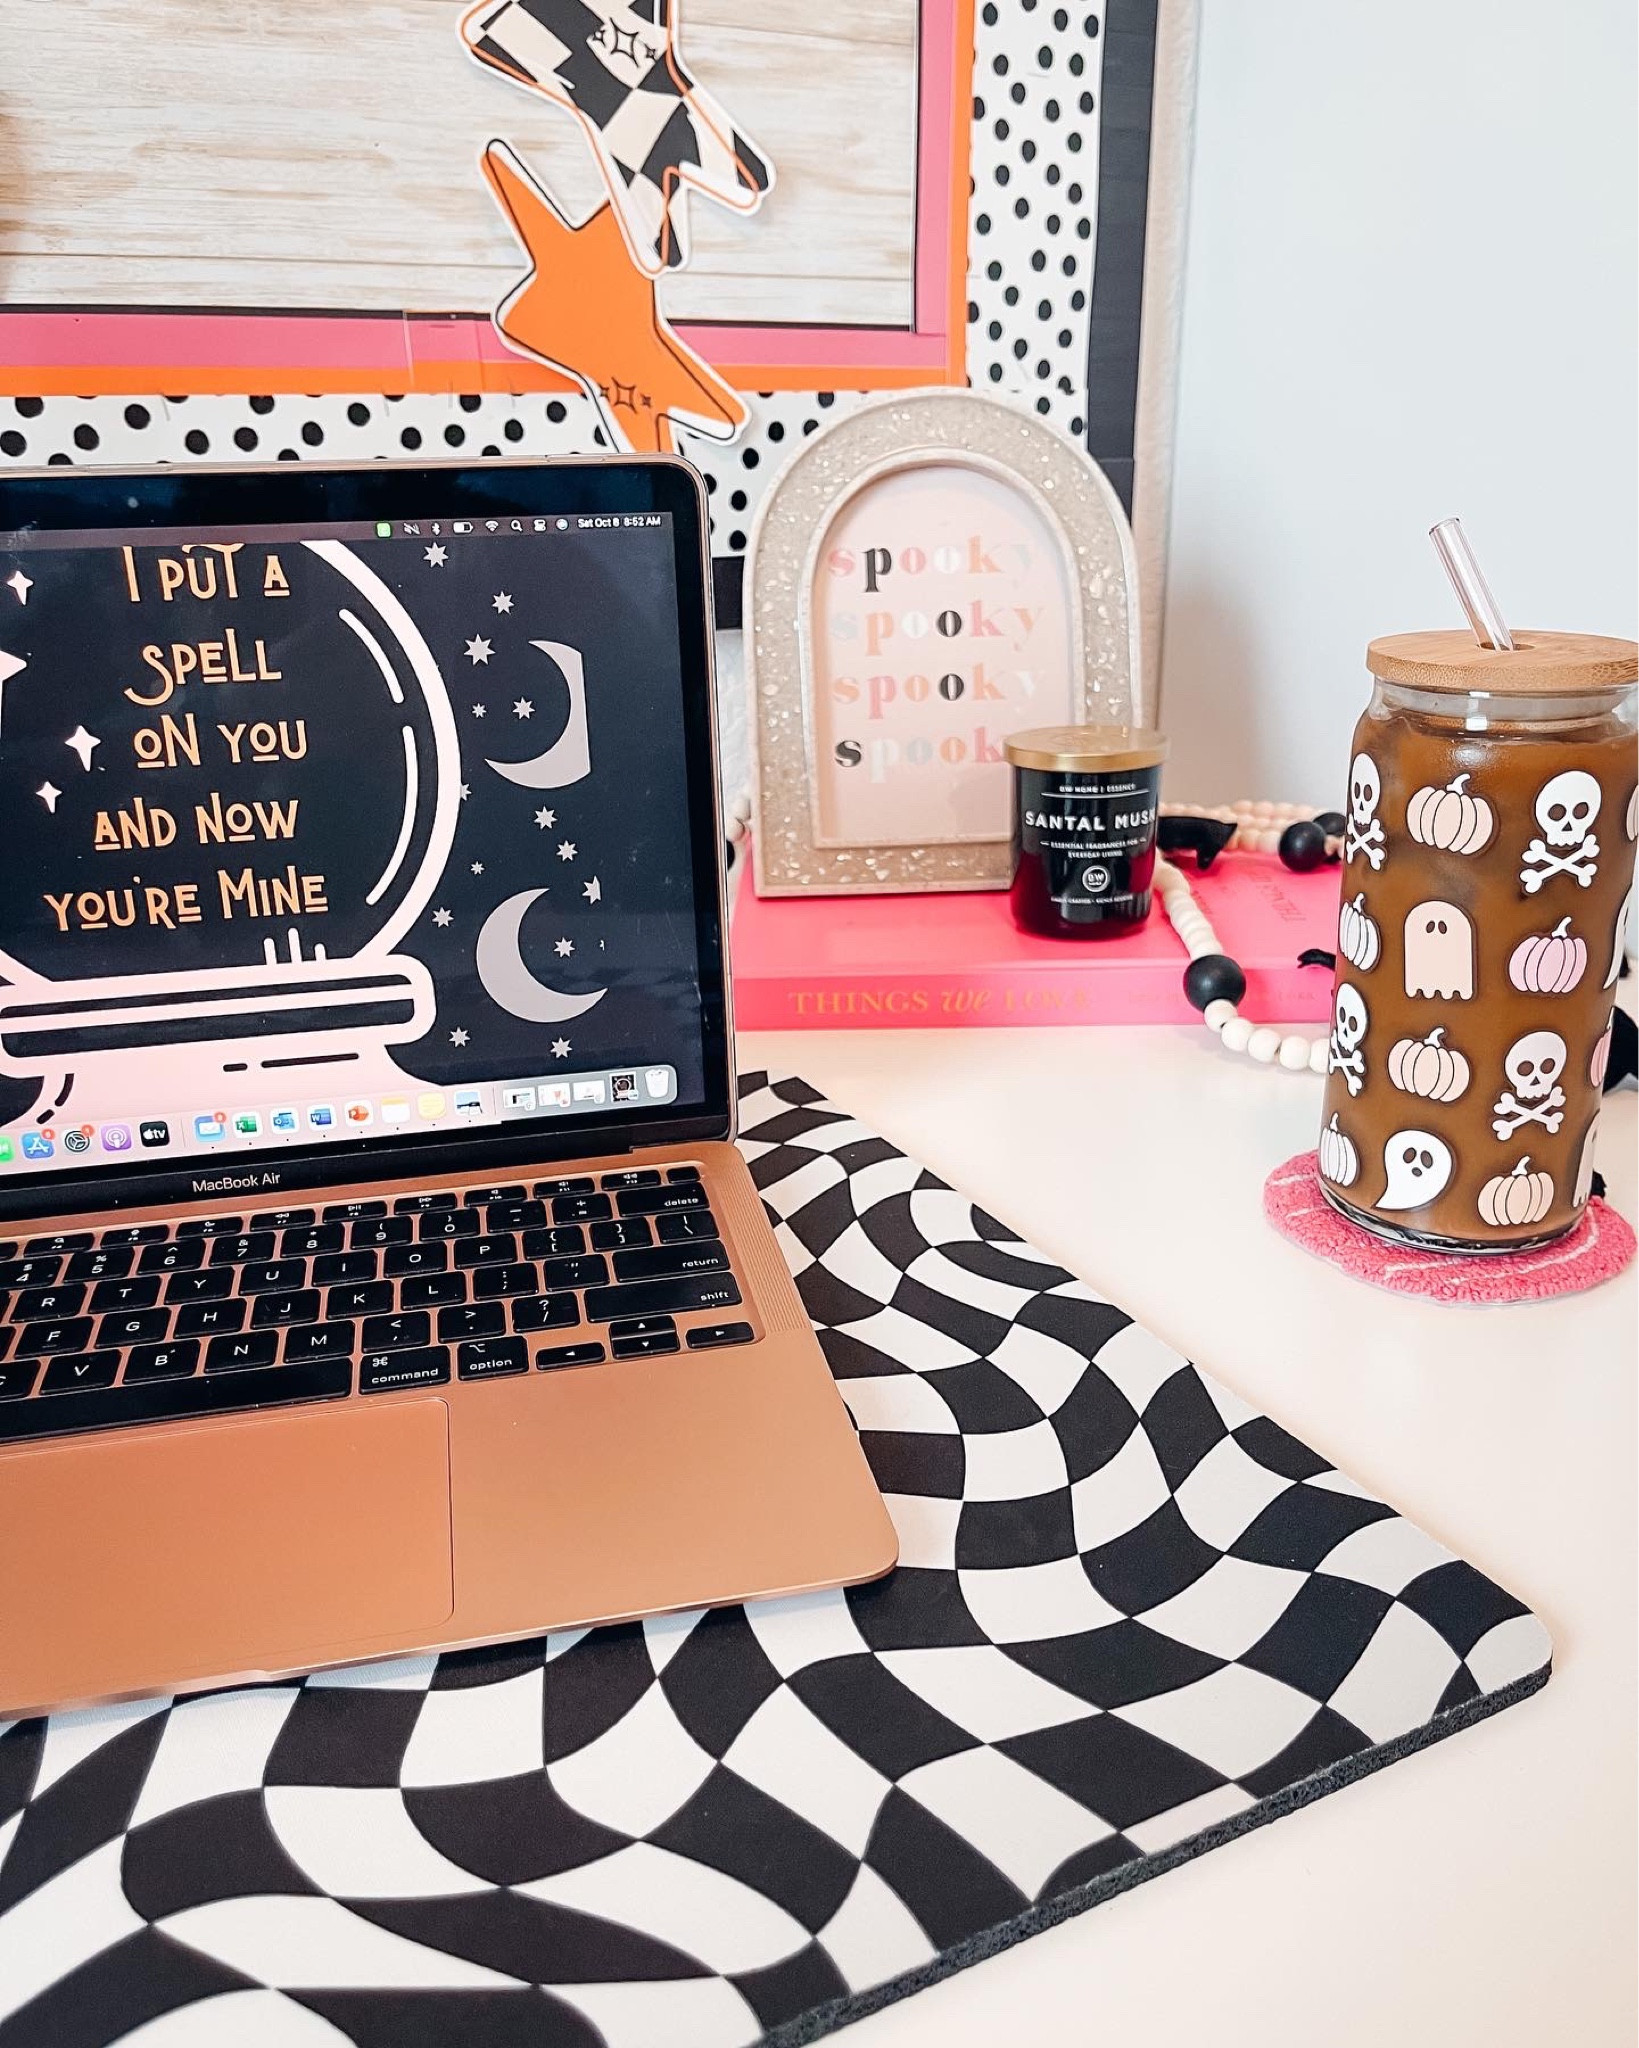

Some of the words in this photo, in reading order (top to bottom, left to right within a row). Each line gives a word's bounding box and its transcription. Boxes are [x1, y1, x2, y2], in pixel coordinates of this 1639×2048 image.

[577, 518, 594, 528] Sat
[595, 517, 612, 528] Oct
[645, 516, 661, 526] AM
[828, 535, 1035, 592] spooky
[121, 545, 141, 602] I
[160, 543, 245, 600] PUT
[263, 553, 290, 597] A
[831, 600, 1043, 656] spooky
[124, 628, 282, 706] SPELL
[832, 662, 1043, 719] spooky
[133, 713, 201, 769] ON
[217, 719, 308, 763] YOU
[835, 726, 1003, 783] spook
[94, 797, 177, 850] AND
[196, 792, 299, 845] NOW
[1025, 811, 1105, 831] SANTAL
[44, 875, 201, 932] YOU'RE
[218, 866, 328, 917] MINE
[788, 989, 929, 1015] THINGS
[940, 990, 992, 1013] we
[193, 1176, 258, 1193] MacBook
[262, 1173, 281, 1186] Air
[664, 1198, 699, 1207] delete
[444, 1223, 456, 1233] 0
[375, 1231, 387, 1241] 9
[306, 1239, 318, 1249] 8
[479, 1245, 491, 1255] P
[237, 1248, 248, 1257] 7
[409, 1253, 422, 1263] O
[163, 1255, 176, 1265] 6
[682, 1258, 719, 1268] return
[91, 1264, 104, 1274] 5
[16, 1273, 29, 1282] 4
[265, 1270, 280, 1281] U
[193, 1279, 207, 1289] Y
[428, 1285, 439, 1295] L
[119, 1288, 132, 1298] T
[353, 1293, 365, 1304] K
[700, 1291, 729, 1301] shift
[41, 1297, 56, 1307] R
[280, 1302, 291, 1313] J
[202, 1311, 218, 1323] H
[125, 1321, 140, 1332] G
[47, 1330, 61, 1342] F
[311, 1334, 327, 1347] M
[233, 1344, 249, 1356] N
[154, 1354, 168, 1366] B
[469, 1357, 513, 1371] option
[74, 1364, 90, 1377] V
[372, 1368, 438, 1383] command
